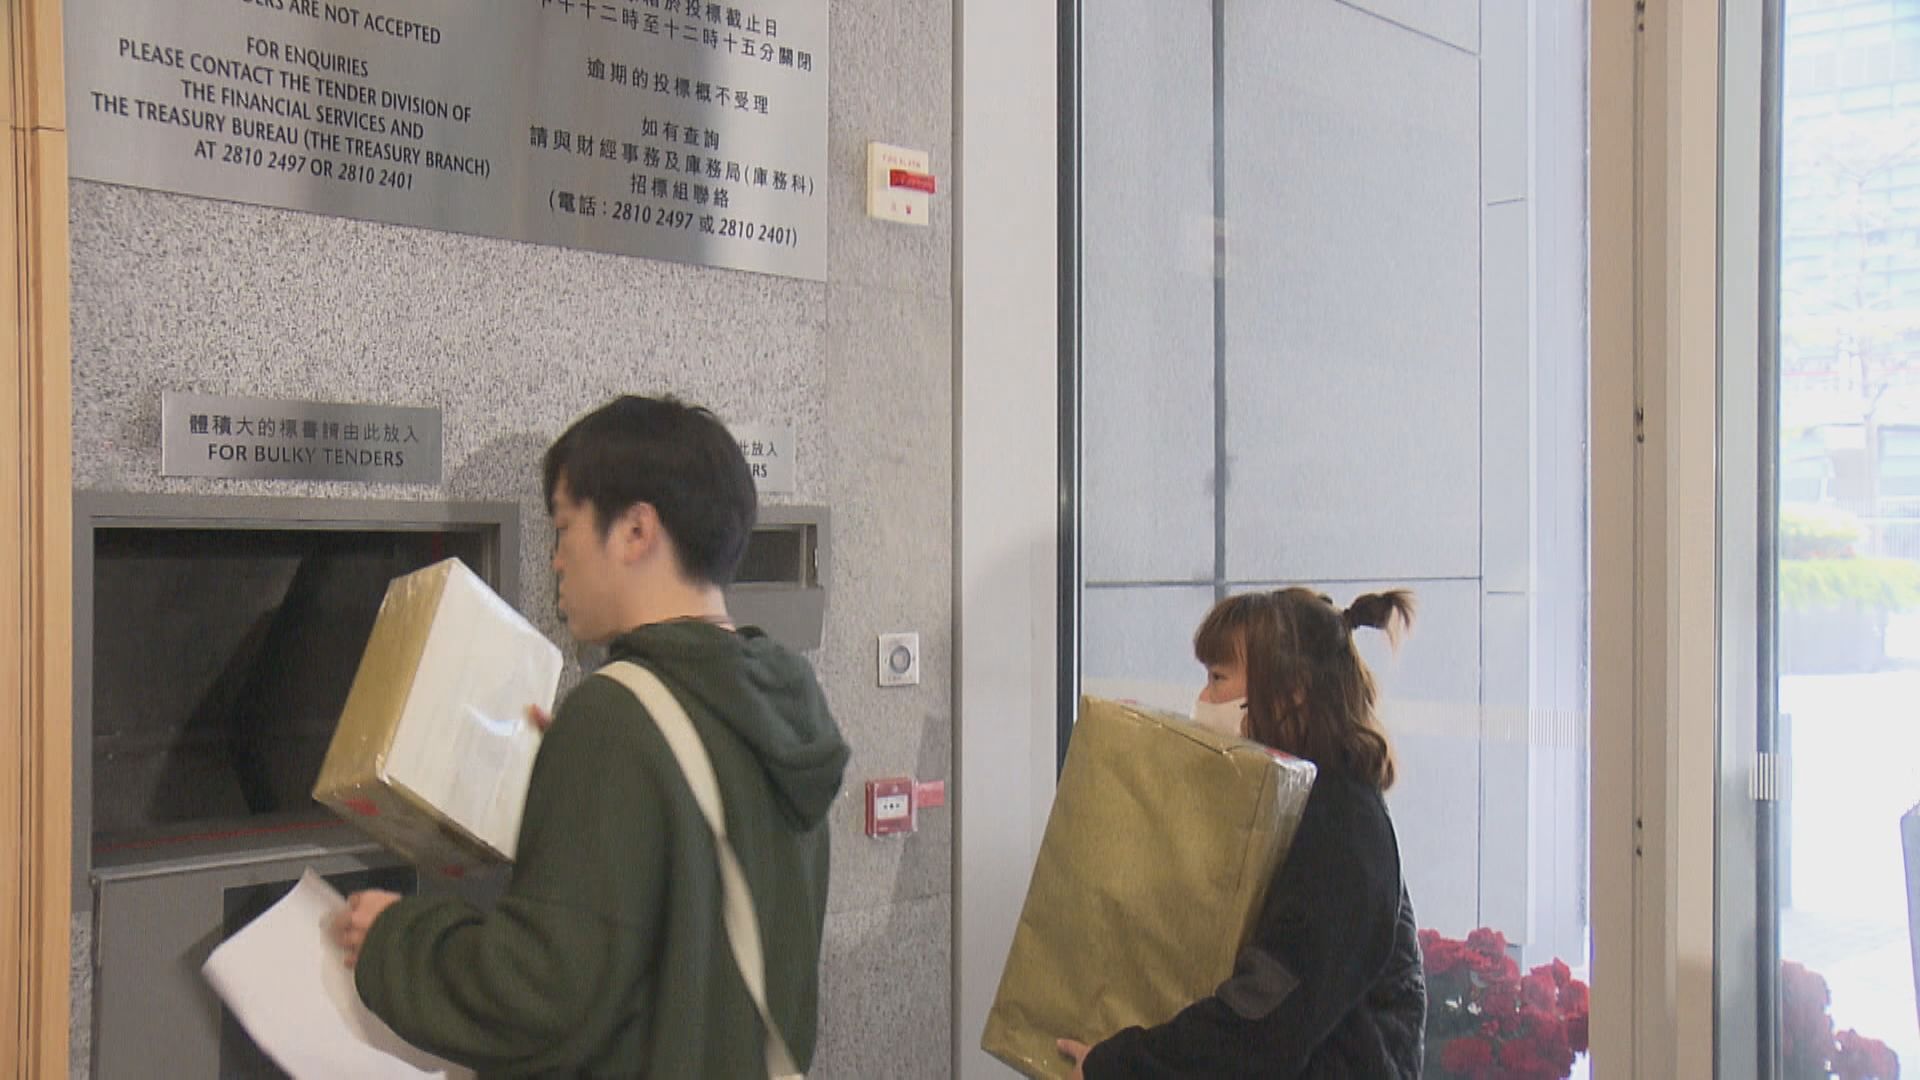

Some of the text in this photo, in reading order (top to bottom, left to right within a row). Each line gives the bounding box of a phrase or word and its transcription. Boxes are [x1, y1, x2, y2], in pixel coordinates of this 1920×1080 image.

[289, 0, 320, 18] ARE
[325, 4, 360, 27] NOT
[363, 13, 441, 45] ACCEPTED
[247, 36, 369, 78] FOR ENQUIRIES
[119, 38, 471, 124] PLEASE CONTACT THE TENDER DIVISION OF
[587, 57, 769, 115] 逾期的投標概不受理
[181, 79, 424, 140] THE FINANCIAL SERVICES AND
[91, 90, 490, 179] THE TREASURY BUREAU (THE TREASURY BRANCH)
[641, 115, 719, 151] 如有查詢
[194, 139, 413, 191] AT 2810 2497 OR 2810 2401
[631, 171, 729, 208] 招標組聯絡
[655, 208, 693, 229] 2497
[699, 213, 715, 235] 或
[718, 218, 754, 240] 2810
[758, 224, 798, 249] 2401)
[189, 414, 419, 443] 體積大的標書請由此放入
[208, 443, 404, 467] FOR BULKY TENDERS
